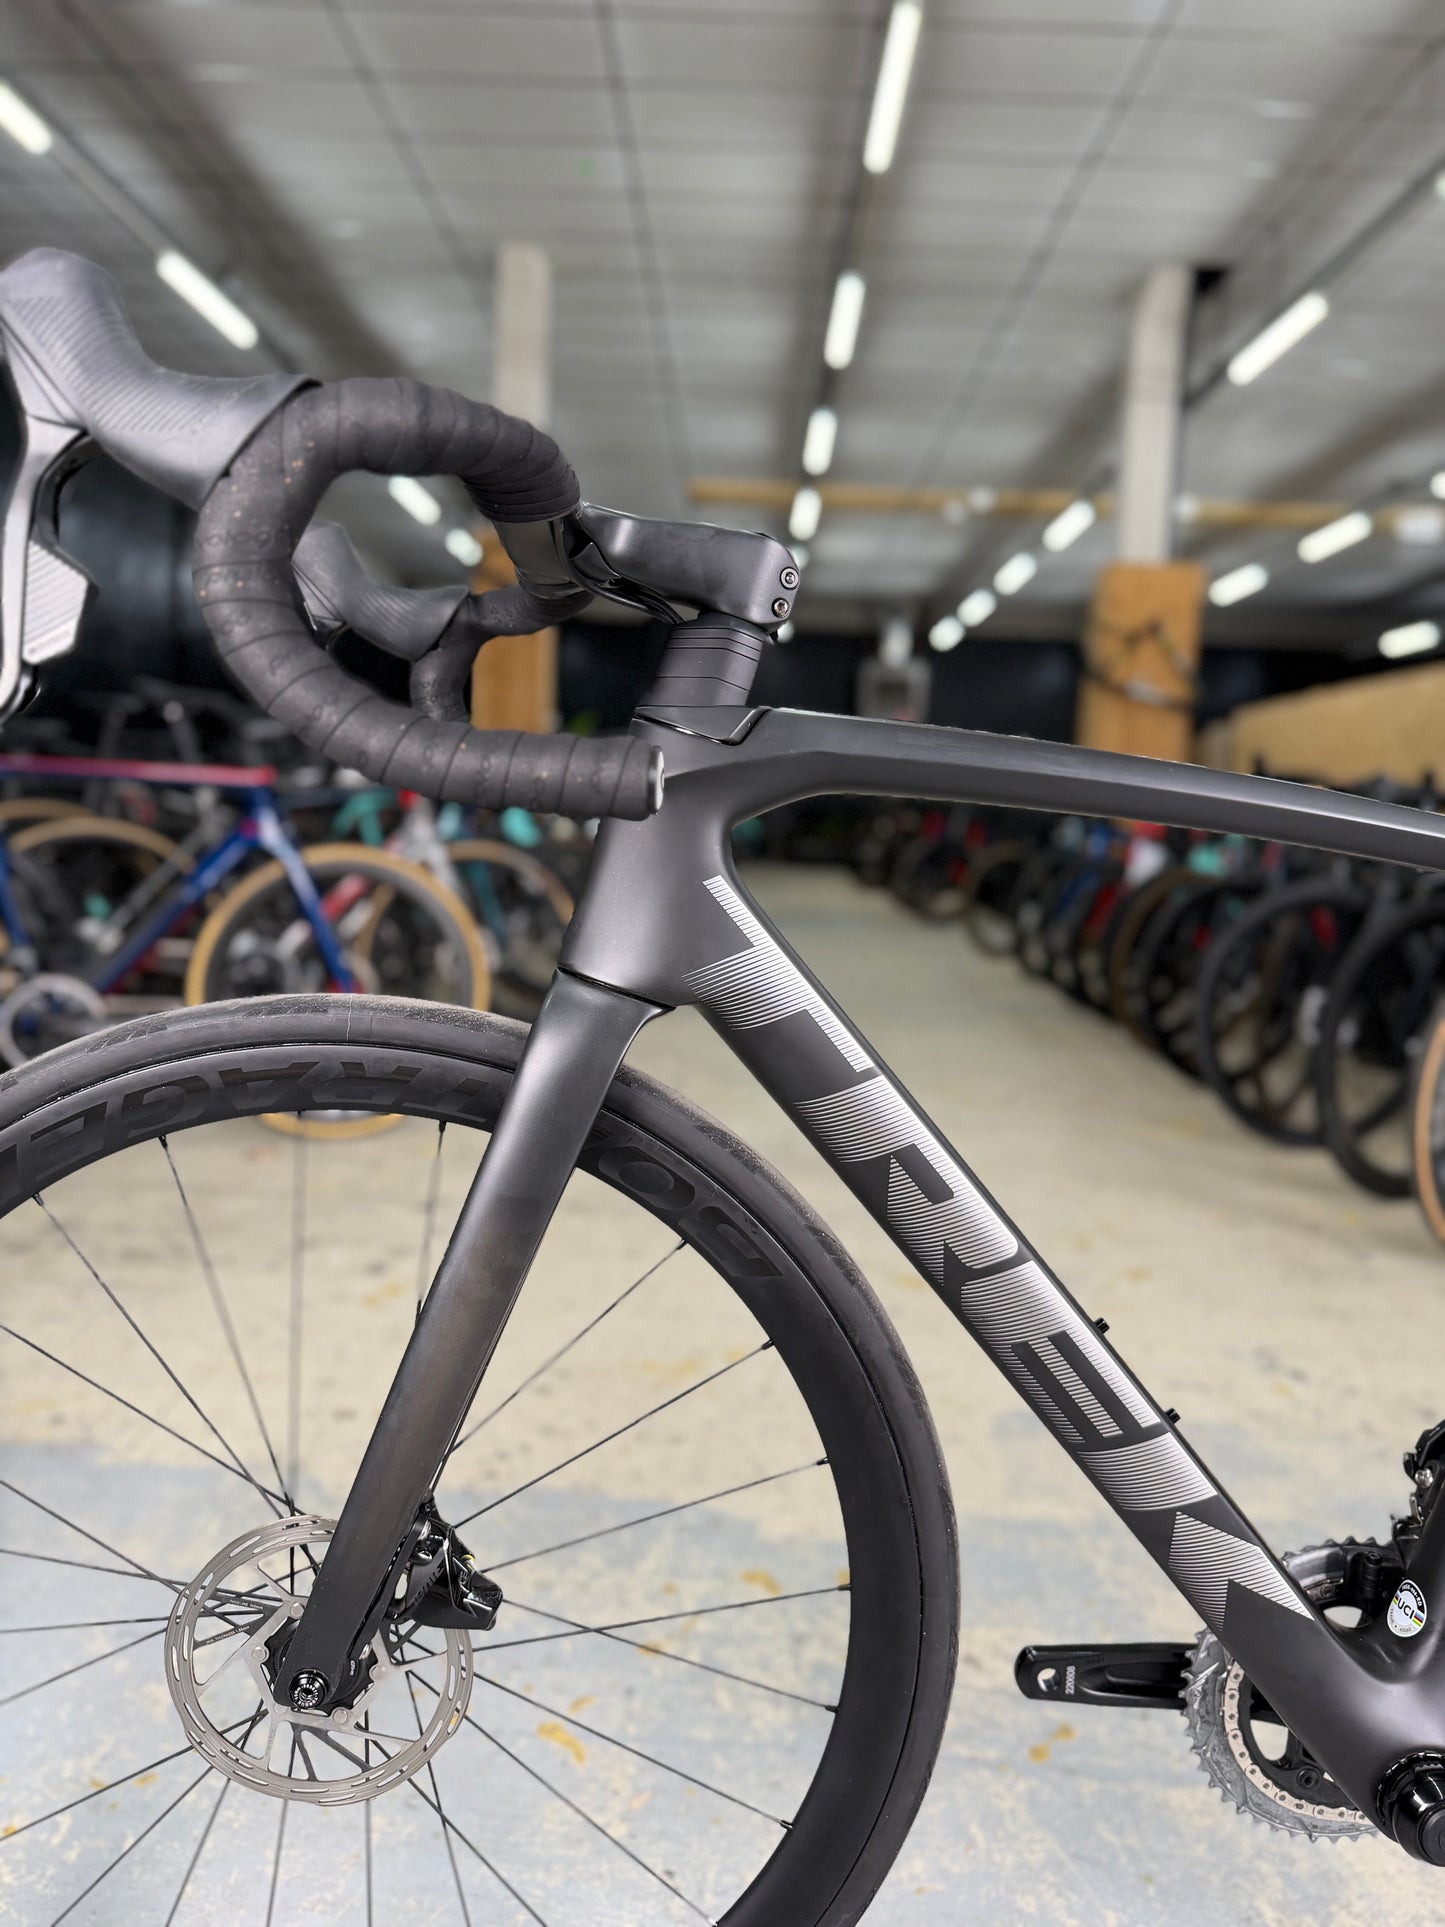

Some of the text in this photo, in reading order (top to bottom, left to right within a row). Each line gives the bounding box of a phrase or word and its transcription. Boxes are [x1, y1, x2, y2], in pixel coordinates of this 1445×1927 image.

[0, 1061, 783, 1278] BOTRAGE
[682, 875, 1314, 1631] TREK
[1397, 1597, 1415, 1620] UCI
